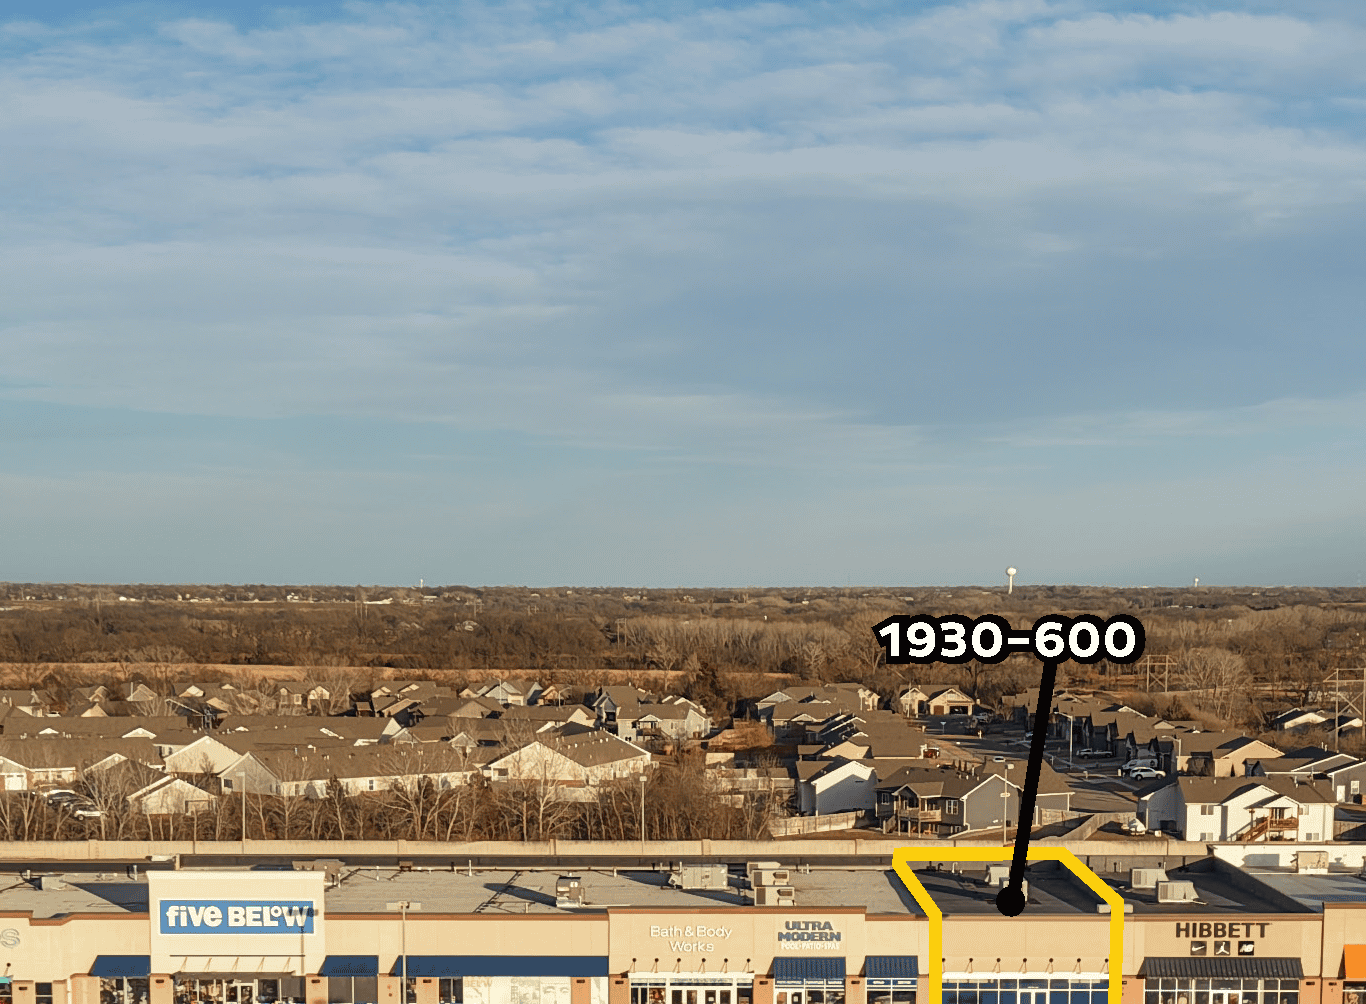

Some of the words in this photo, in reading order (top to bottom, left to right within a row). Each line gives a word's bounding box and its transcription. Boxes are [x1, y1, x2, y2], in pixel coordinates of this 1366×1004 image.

[166, 905, 223, 927] five
[785, 920, 834, 931] ULTRA
[1175, 922, 1272, 938] HIBBETT
[650, 925, 682, 938] Bath
[684, 925, 694, 937] &
[696, 925, 733, 940] Body
[777, 931, 842, 942] MODERN
[668, 940, 715, 952] Works
